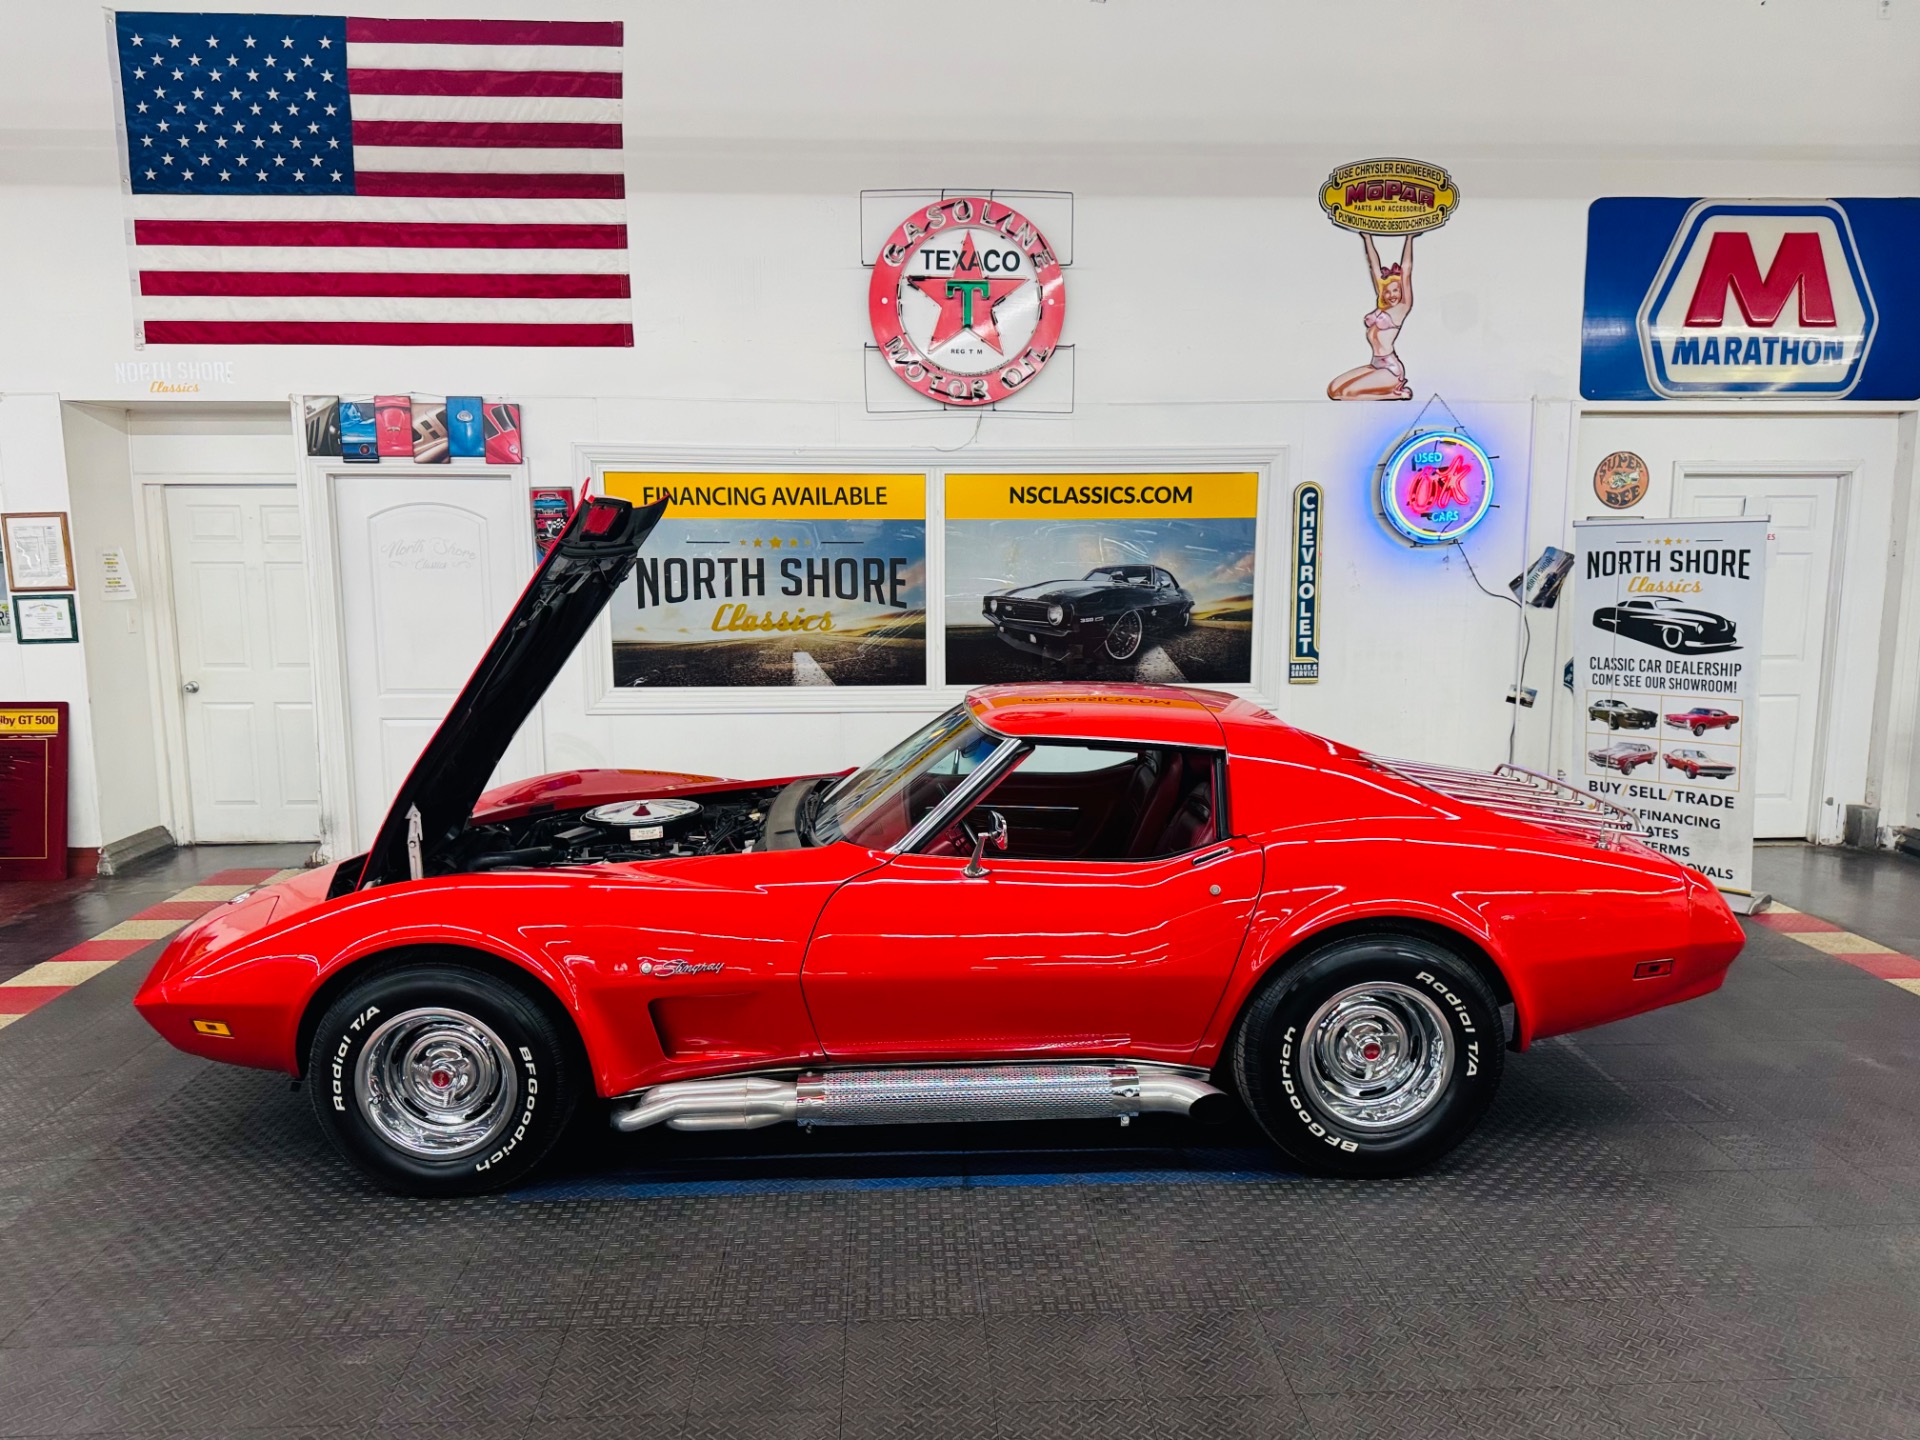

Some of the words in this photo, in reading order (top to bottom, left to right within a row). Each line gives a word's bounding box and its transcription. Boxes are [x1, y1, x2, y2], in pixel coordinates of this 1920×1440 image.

[1338, 169, 1354, 181] USE
[1355, 163, 1394, 176] CHRYSLER
[1395, 163, 1442, 182] ENGINEERED
[1354, 204, 1372, 212] PARTS
[1388, 204, 1427, 213] ACCESSORIES
[883, 198, 1056, 272] GASOLINE
[920, 249, 1021, 272] TEXACO
[1671, 336, 1844, 366] MARATHON
[114, 360, 171, 384] NORTH
[177, 360, 235, 384] SHORE
[885, 335, 992, 402] MOTOR
[1002, 346, 1051, 389] OIL
[149, 380, 200, 393] Classics
[1414, 451, 1442, 463] USED
[643, 486, 766, 507] FINANCING
[771, 485, 888, 506] AVAILABLE
[1009, 485, 1193, 504] NSCLASSICS.COM
[1431, 510, 1459, 522] CARS
[1298, 492, 1317, 654] CHEVROLET
[1586, 550, 1661, 579] NORTH
[1669, 548, 1751, 580] SHORE
[635, 557, 765, 610] NORTH
[780, 557, 908, 609] SHORE
[1627, 576, 1703, 593] Classics
[711, 603, 836, 632] Classics
[1290, 670, 1318, 678] SERVICE
[1291, 663, 1312, 671] SALES
[1589, 656, 1635, 673] CLASSIC
[1639, 659, 1662, 674] CAR
[1665, 660, 1742, 677] DEALERSHIP
[1592, 673, 1621, 687] COME
[1623, 675, 1642, 688] SEE
[1645, 676, 1666, 690] OUR
[1668, 676, 1738, 694] SHOWROOM!
[18, 715, 34, 725] GT
[35, 715, 56, 725] 500
[1639, 808, 1721, 830] FINANCING
[1644, 825, 1679, 840] ATES
[654, 958, 725, 977] Stingray
[1415, 971, 1476, 1033] Radial
[1466, 1041, 1479, 1077] T/A
[332, 1035, 352, 1111] Radial
[350, 1005, 380, 1032] T/A
[1280, 1026, 1359, 1153] BFGoodrich
[476, 1046, 538, 1172] BFGoodrich
